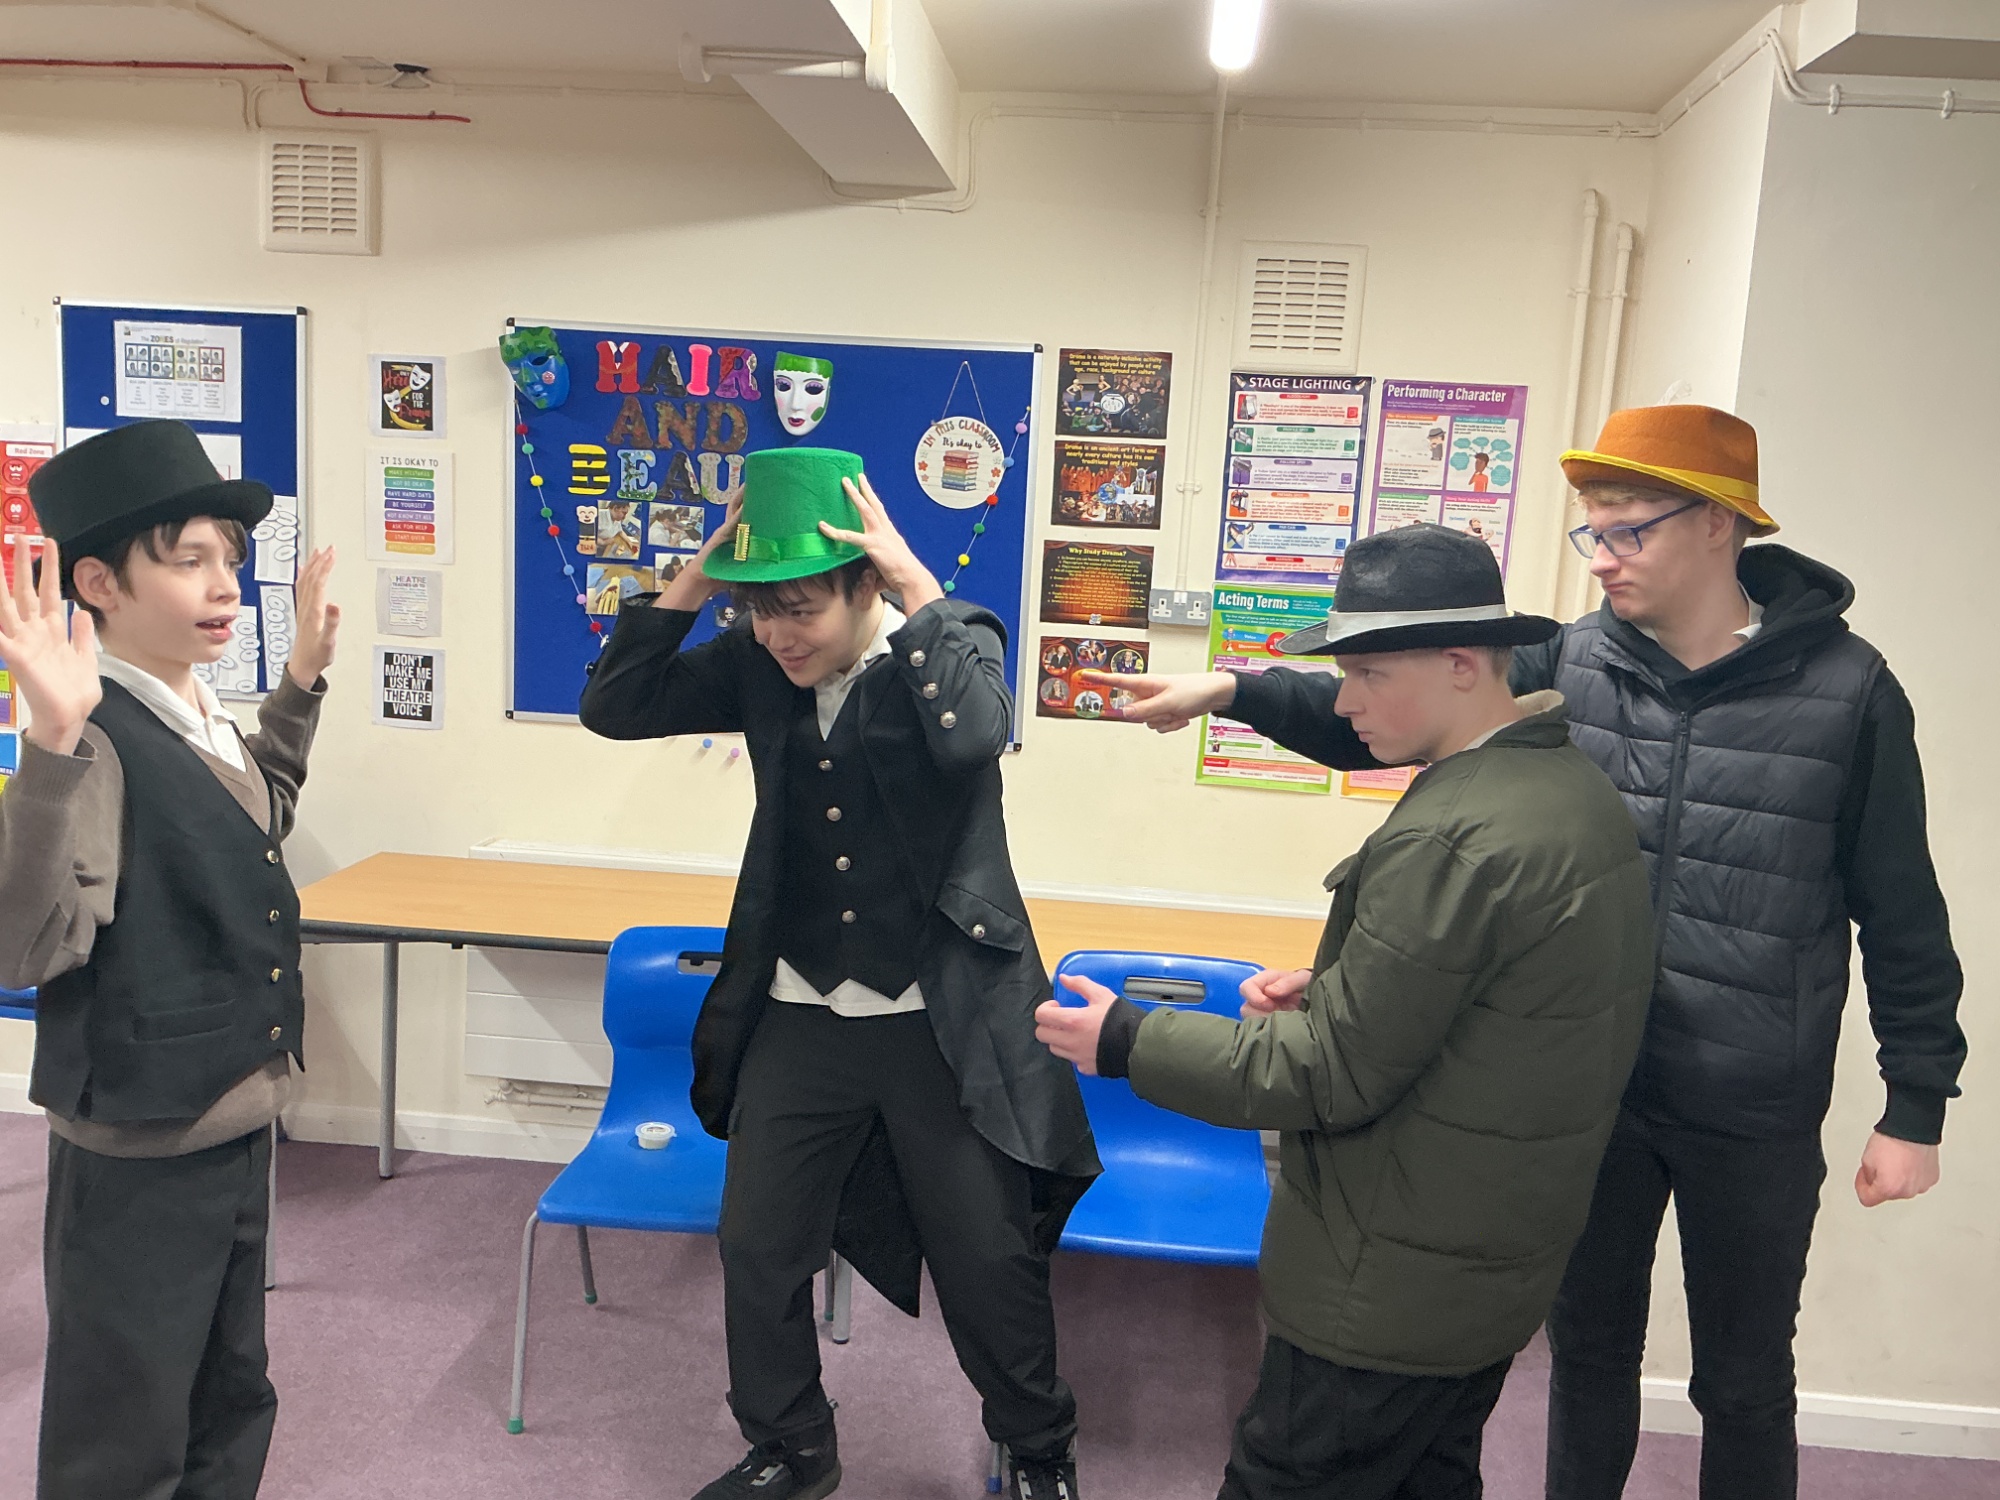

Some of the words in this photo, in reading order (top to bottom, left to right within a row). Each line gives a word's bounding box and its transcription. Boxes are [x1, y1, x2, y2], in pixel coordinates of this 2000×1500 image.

[596, 340, 762, 402] HAIR
[1248, 376, 1289, 389] STAGE
[1292, 378, 1352, 390] LIGHTING
[412, 392, 424, 400] FOR
[1388, 384, 1445, 402] Performing
[1455, 387, 1506, 402] Character
[413, 400, 424, 408] THE
[606, 396, 748, 452] AND
[924, 434, 936, 448] IN
[935, 420, 955, 436] THIS
[958, 419, 1001, 453] CLASSROOM
[942, 436, 954, 447] It's
[974, 440, 982, 449] to
[1066, 450, 1083, 458] nearly
[380, 457, 390, 465] IT
[393, 457, 402, 466] IS
[405, 458, 426, 467] OKAY
[429, 459, 438, 468] TO
[568, 443, 745, 505] BEAU
[1068, 548, 1082, 556] Why
[1084, 548, 1100, 556] Study
[1102, 548, 1127, 556] Drama?
[1218, 592, 1254, 610] Acting
[1256, 595, 1290, 610] Terms
[393, 653, 424, 667] DON'T
[385, 664, 414, 678] MAKE
[416, 668, 432, 680] ME
[390, 676, 410, 689] USE
[412, 678, 427, 690] MY
[386, 690, 431, 704] THEATRE
[392, 703, 423, 718] VOICE
